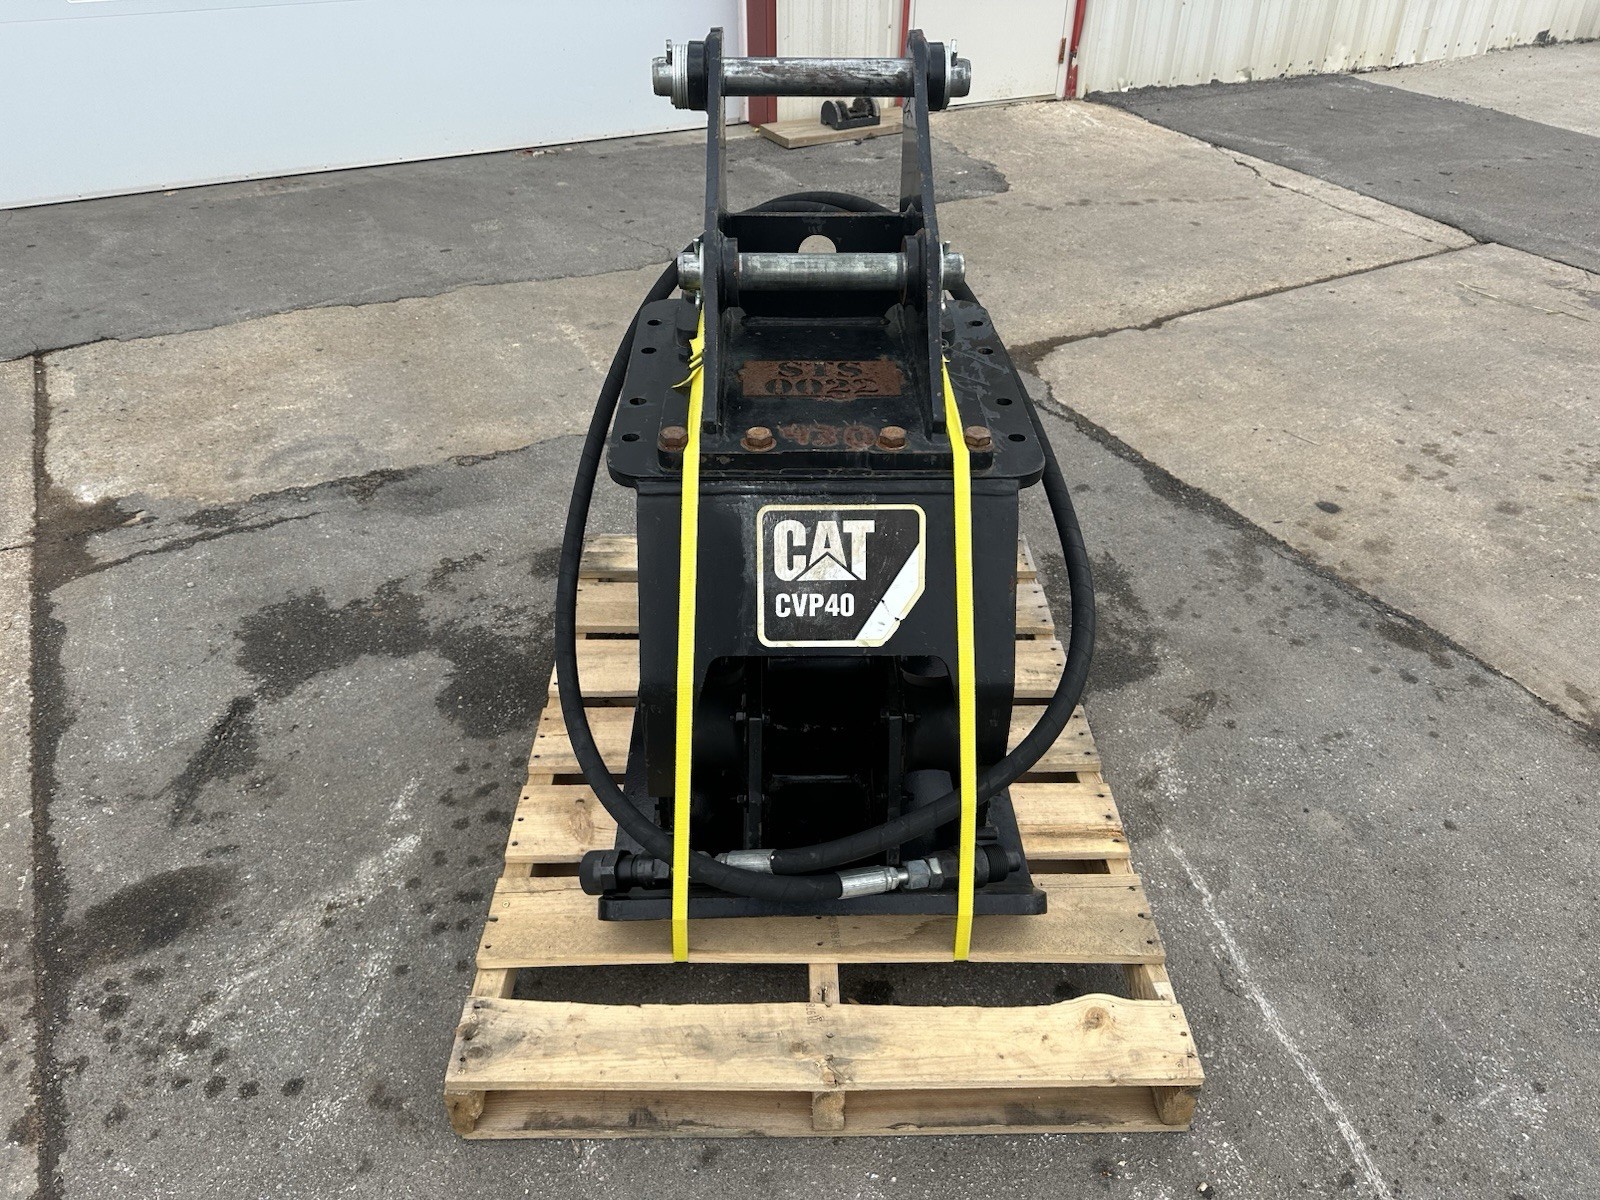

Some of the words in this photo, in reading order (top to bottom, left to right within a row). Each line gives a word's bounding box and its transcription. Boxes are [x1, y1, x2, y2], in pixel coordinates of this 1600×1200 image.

[778, 362, 862, 377] STS
[765, 378, 879, 395] 0022
[774, 519, 875, 581] CAT
[775, 592, 855, 618] CVP40
